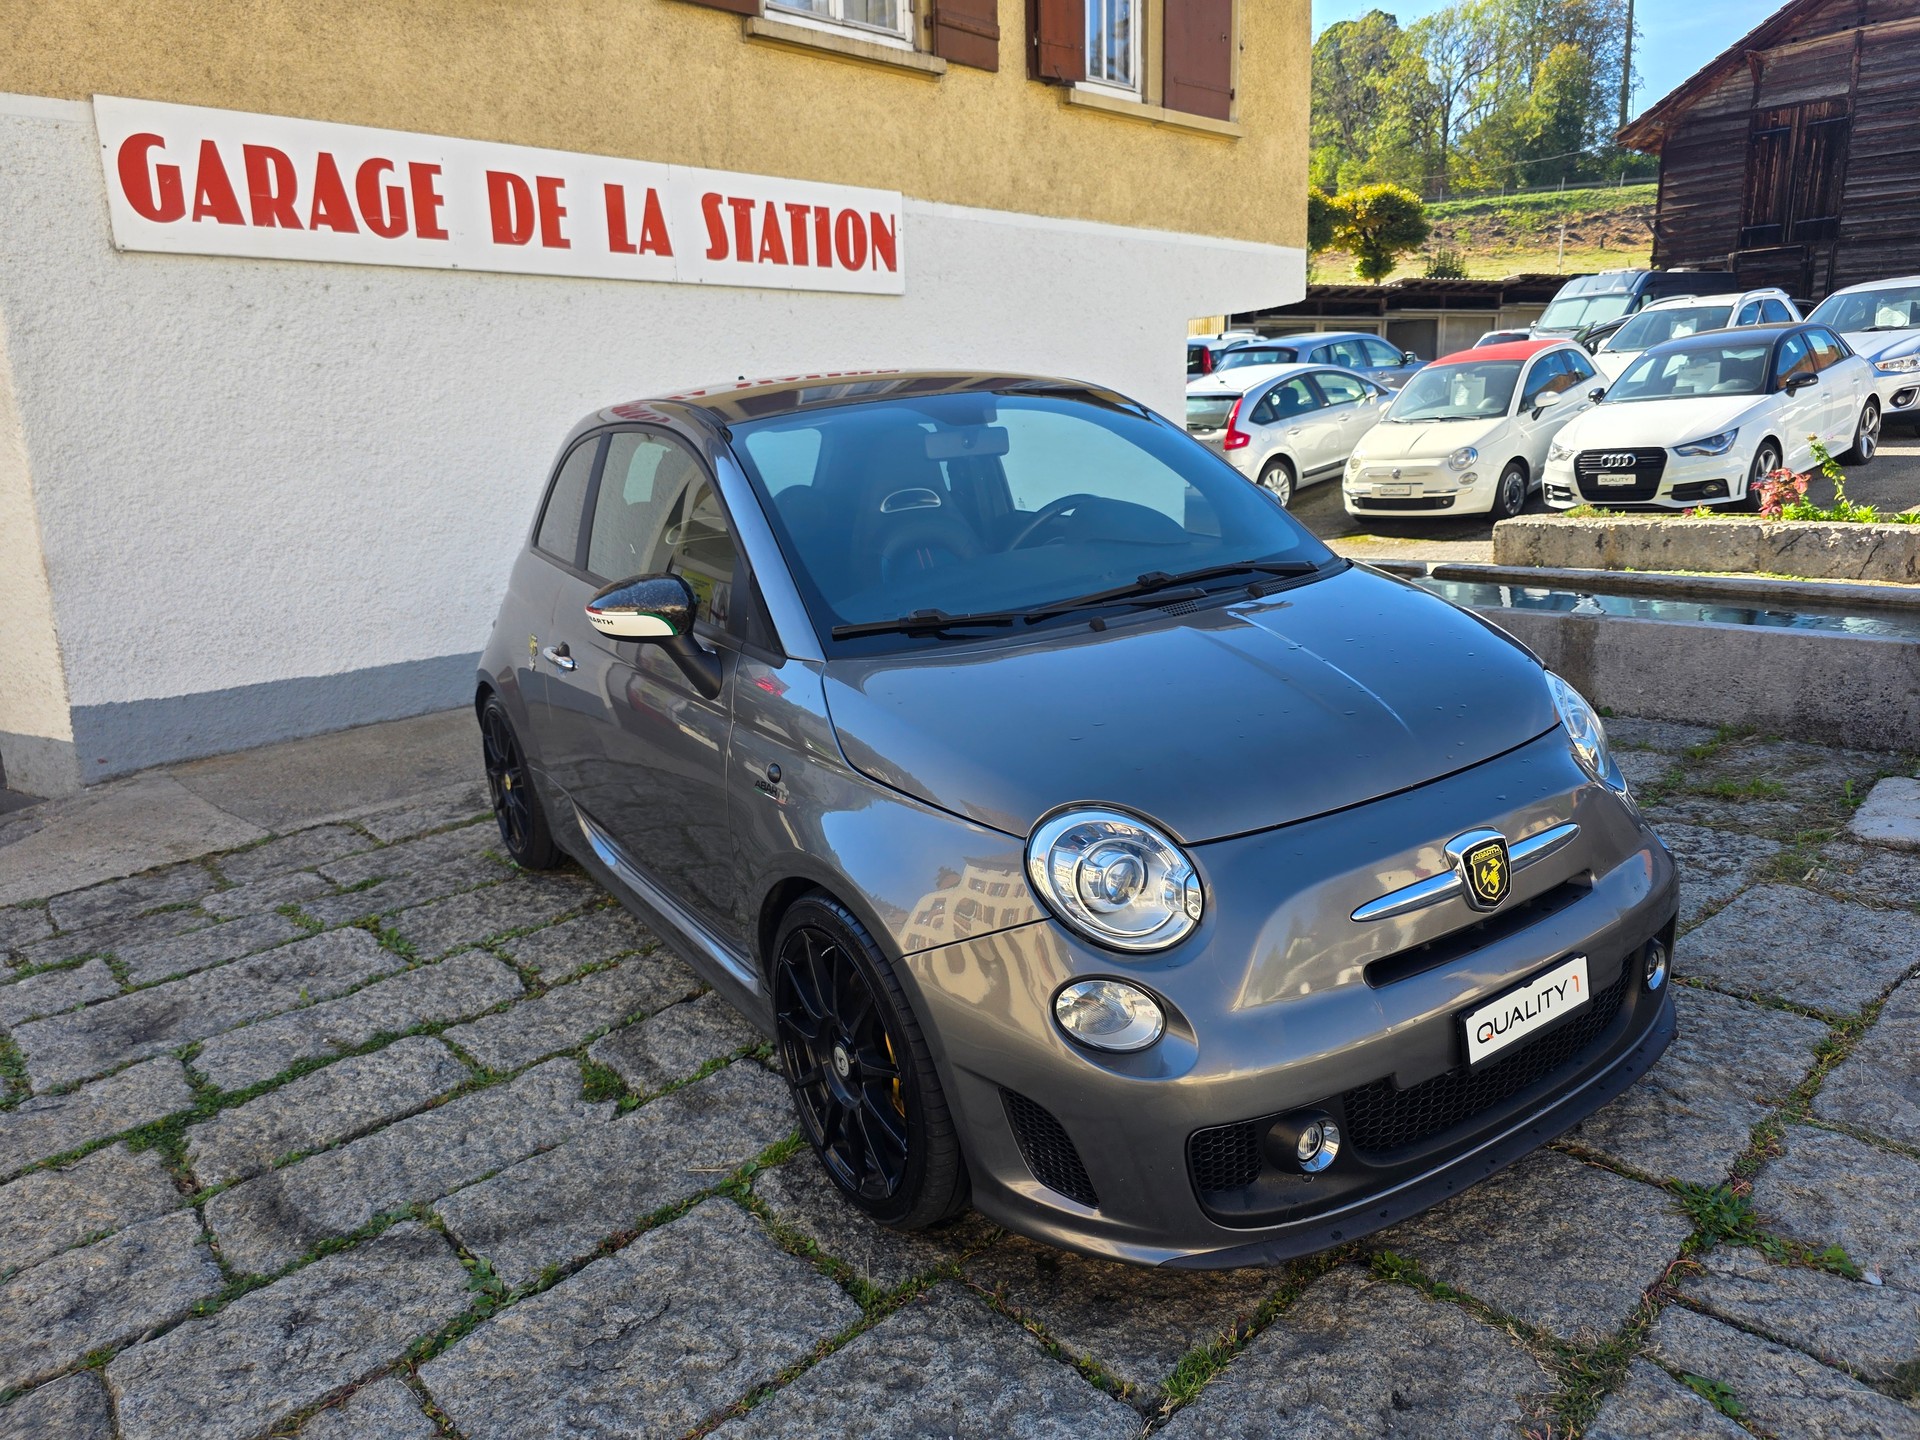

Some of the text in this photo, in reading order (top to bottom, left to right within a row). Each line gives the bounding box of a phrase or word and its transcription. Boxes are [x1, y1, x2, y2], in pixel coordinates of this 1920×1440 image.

[117, 132, 897, 272] GARAGE DE LA STATION
[1474, 847, 1501, 861] ABARTH
[1476, 975, 1579, 1044] QUALITY 1
